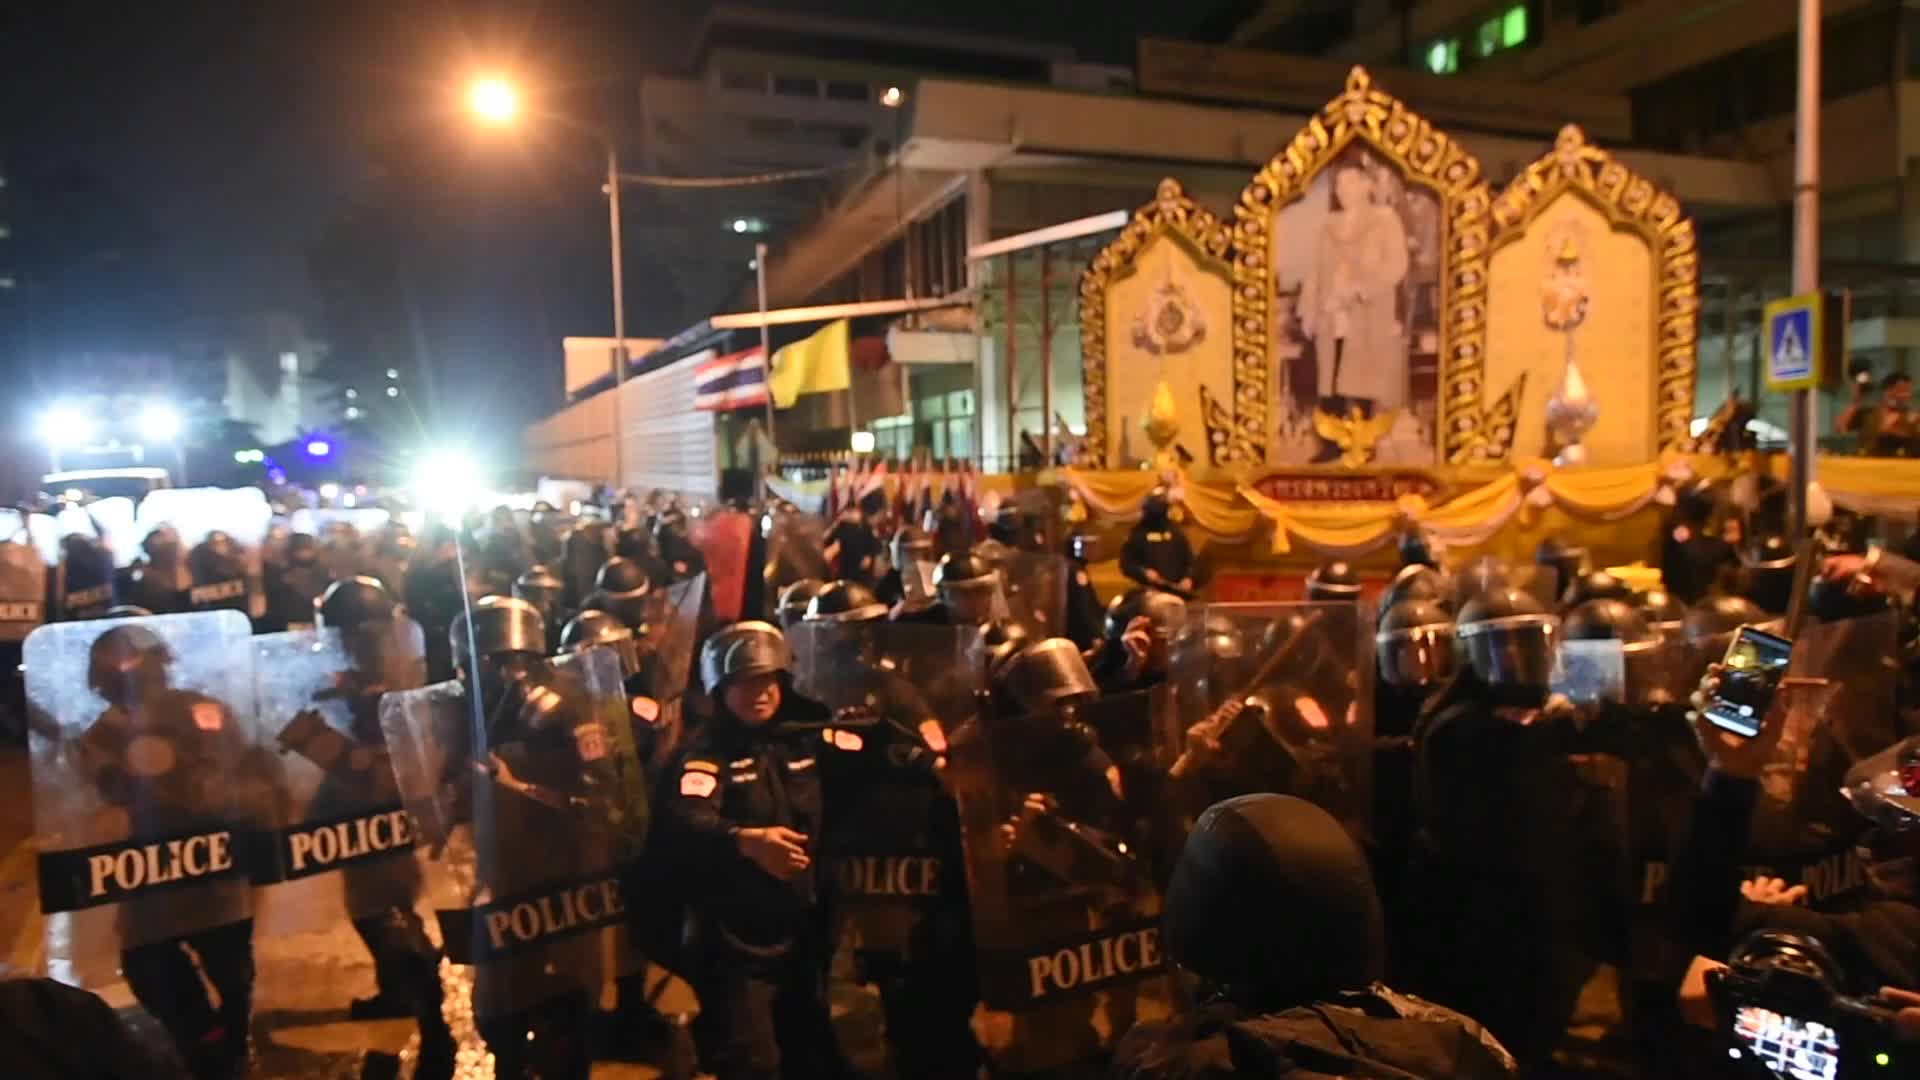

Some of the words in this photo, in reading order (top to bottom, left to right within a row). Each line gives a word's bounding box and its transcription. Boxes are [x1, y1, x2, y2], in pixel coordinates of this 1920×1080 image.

[88, 831, 232, 896] POLICE
[288, 809, 411, 870] POLICE
[486, 879, 625, 949] POLICE
[1029, 928, 1160, 998] POLICE
